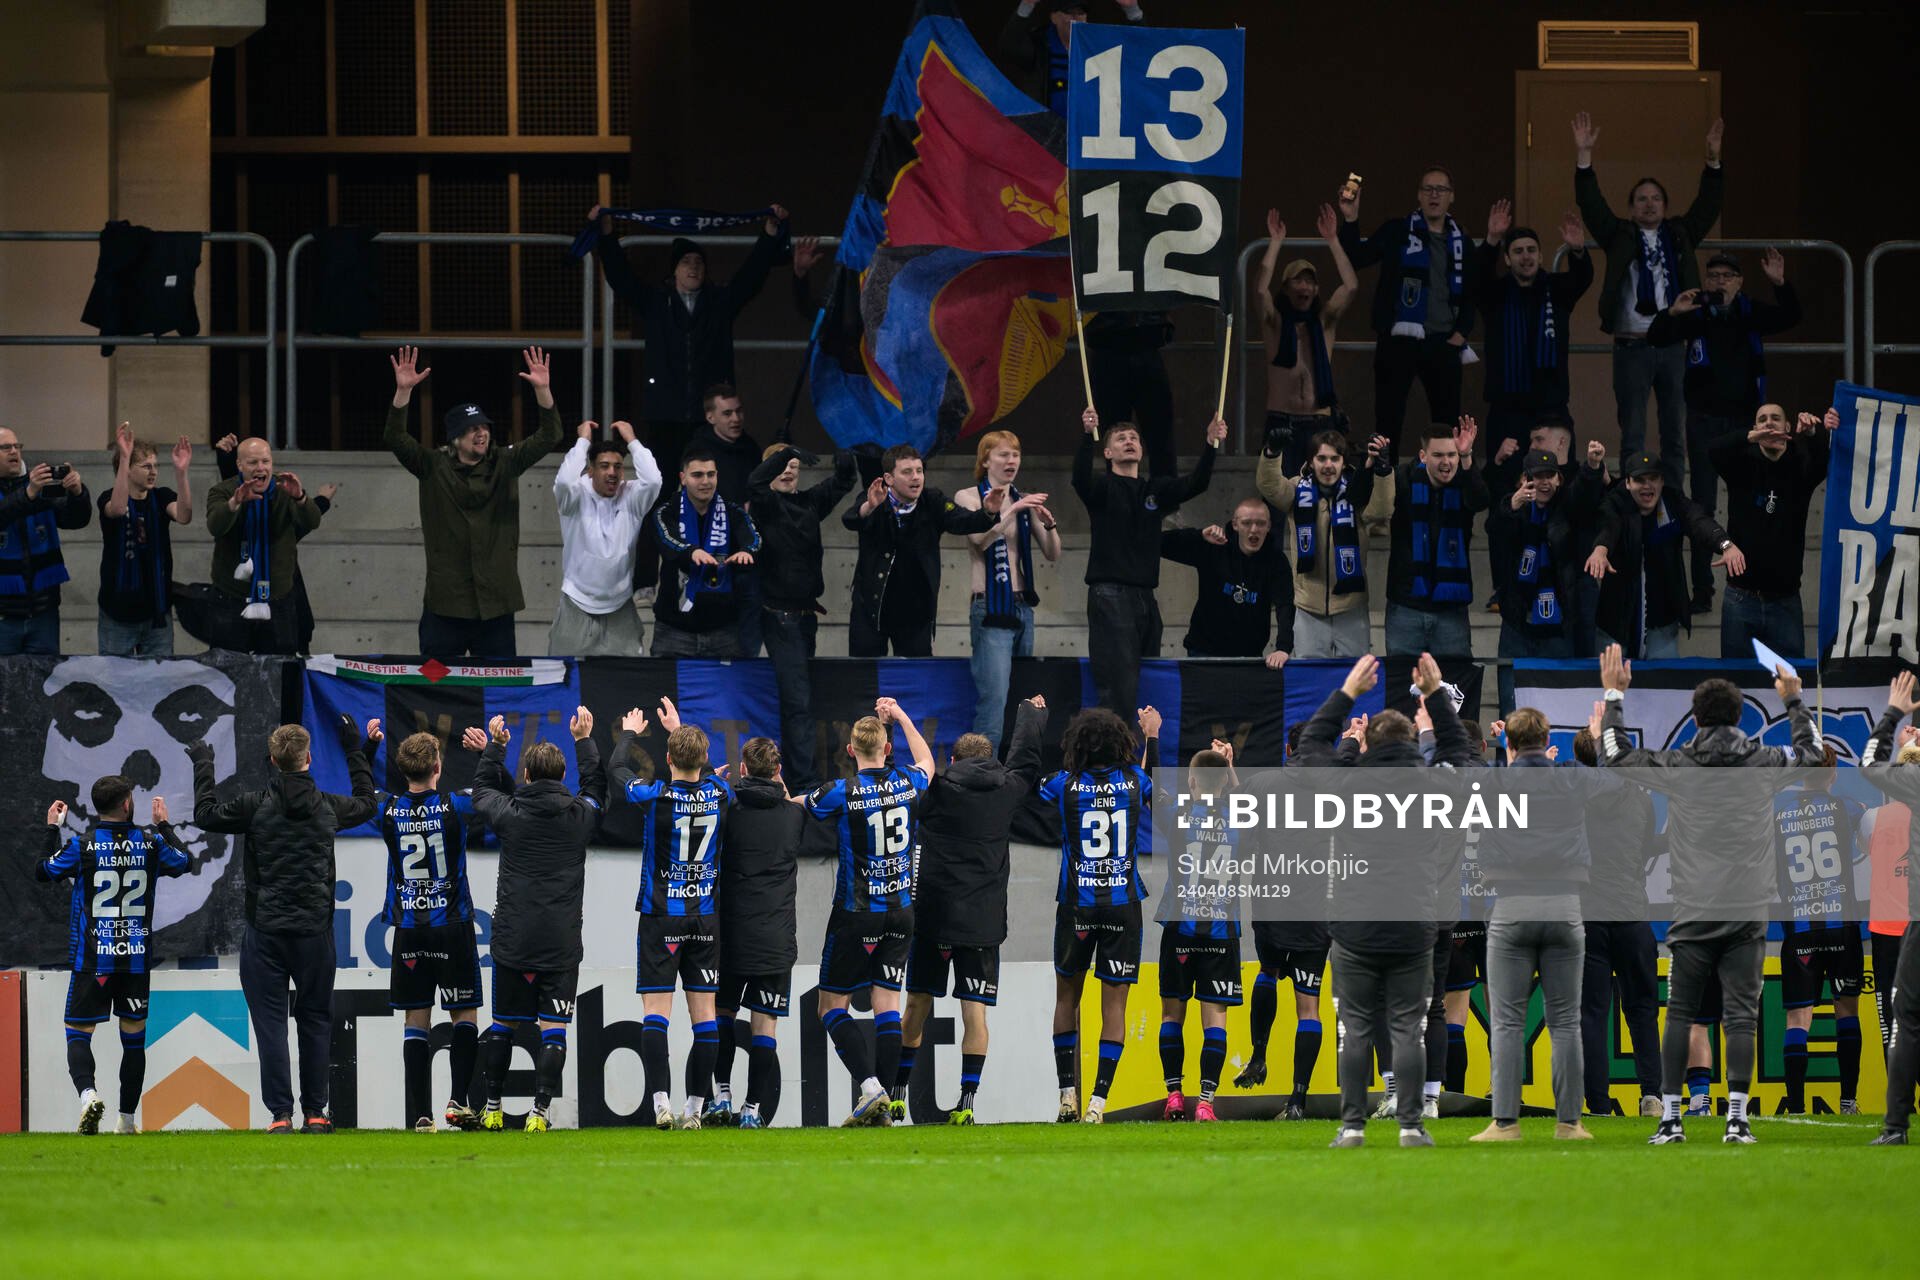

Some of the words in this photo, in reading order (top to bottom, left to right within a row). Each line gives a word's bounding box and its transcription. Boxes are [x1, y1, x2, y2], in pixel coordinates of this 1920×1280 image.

[1080, 44, 1229, 163] 13
[1080, 180, 1223, 300] 12
[345, 660, 407, 675] PALESTINE
[461, 667, 525, 677] PALESTINE
[852, 785, 885, 796] ÅRSTA
[894, 778, 911, 789] TAK
[1070, 781, 1102, 793] ÅRSTA
[1115, 780, 1135, 791] TAK
[385, 806, 417, 817] ÅRSTA
[429, 803, 450, 813] TAK
[675, 800, 719, 813] LINDBERG
[848, 795, 895, 811] VOELKERLING
[1091, 796, 1116, 809] JENG
[1775, 808, 1804, 822] ÅRSTA
[1817, 802, 1838, 813] TAK
[397, 819, 441, 833] WIDGREN
[866, 806, 910, 857] 13
[1780, 815, 1835, 834] LJUNGBERG
[674, 814, 718, 862] 17
[1081, 809, 1127, 858] 31
[1196, 830, 1228, 843] WALTA
[86, 841, 121, 851] ÅRSTA
[134, 841, 154, 850] TAK
[98, 855, 145, 867] ALSANATI
[400, 832, 448, 880] 21
[1185, 842, 1233, 887] 14
[1784, 830, 1842, 883] 36
[660, 869, 718, 881] WELLNESS
[671, 862, 712, 872] NORDIC
[91, 869, 148, 918] 22
[869, 876, 911, 895] inkClub
[1787, 884, 1847, 902] WELLNESS
[1795, 879, 1837, 894] NORDIC
[1182, 902, 1228, 919] inkClub
[1793, 900, 1842, 918] inkClub
[91, 927, 149, 938] WELLNESS
[98, 920, 138, 929] NORDIC
[96, 941, 146, 956] inkClub
